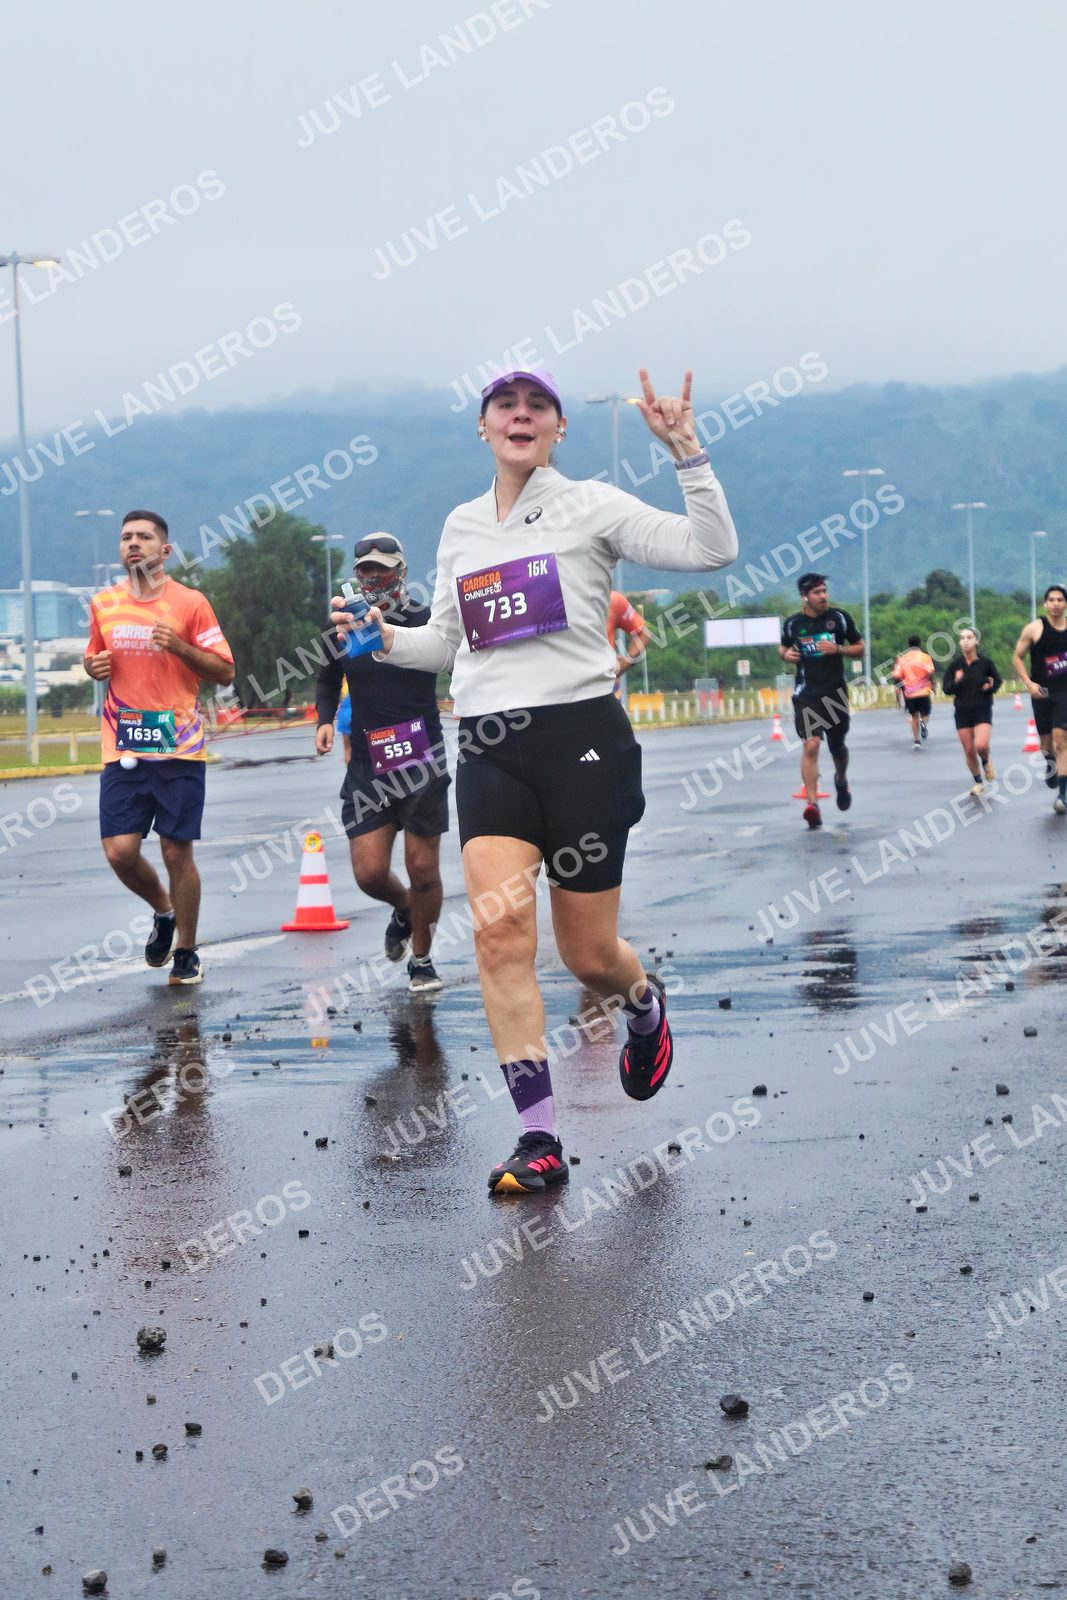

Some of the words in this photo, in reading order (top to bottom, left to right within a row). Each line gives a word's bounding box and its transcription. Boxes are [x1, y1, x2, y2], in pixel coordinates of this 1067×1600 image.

[463, 571, 501, 593] CARRERA
[483, 592, 528, 623] 733
[126, 727, 162, 741] 1639
[384, 741, 412, 758] 553
